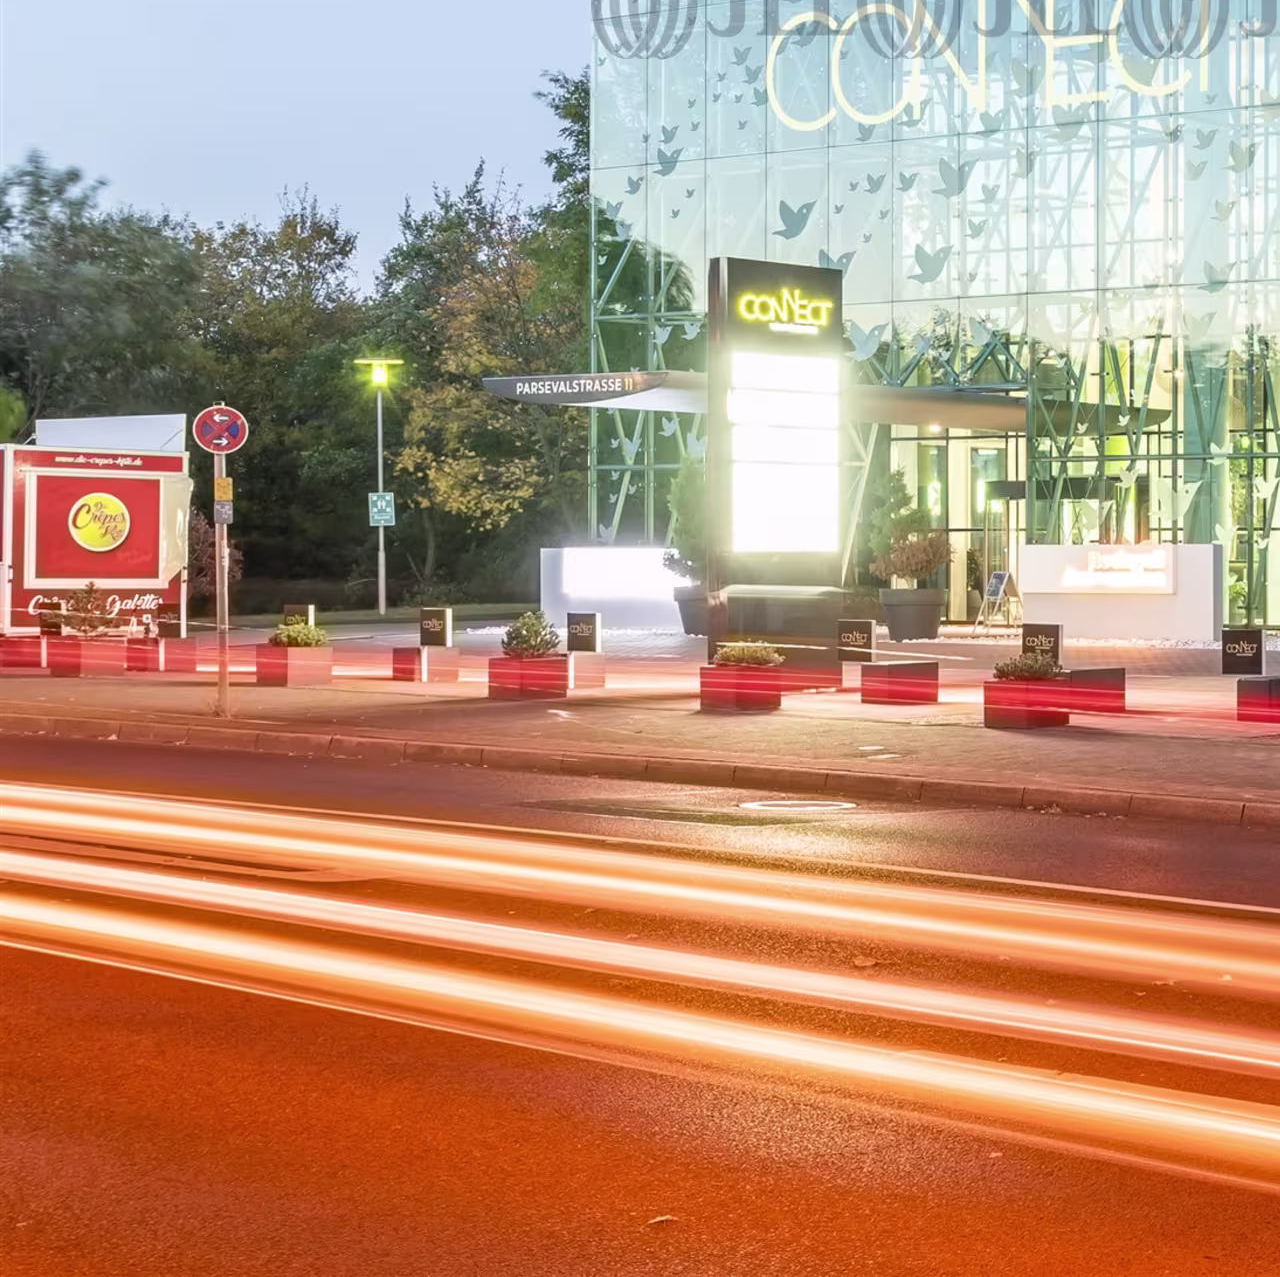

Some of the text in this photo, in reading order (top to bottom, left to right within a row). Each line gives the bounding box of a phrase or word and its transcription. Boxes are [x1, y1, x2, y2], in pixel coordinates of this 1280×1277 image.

[739, 286, 833, 326] CONNECT
[516, 378, 633, 395] PARSEVALSTRASSE 11
[106, 594, 163, 617] Galette
[1025, 634, 1055, 647] CONNECT
[1226, 640, 1258, 653] CONNECT
